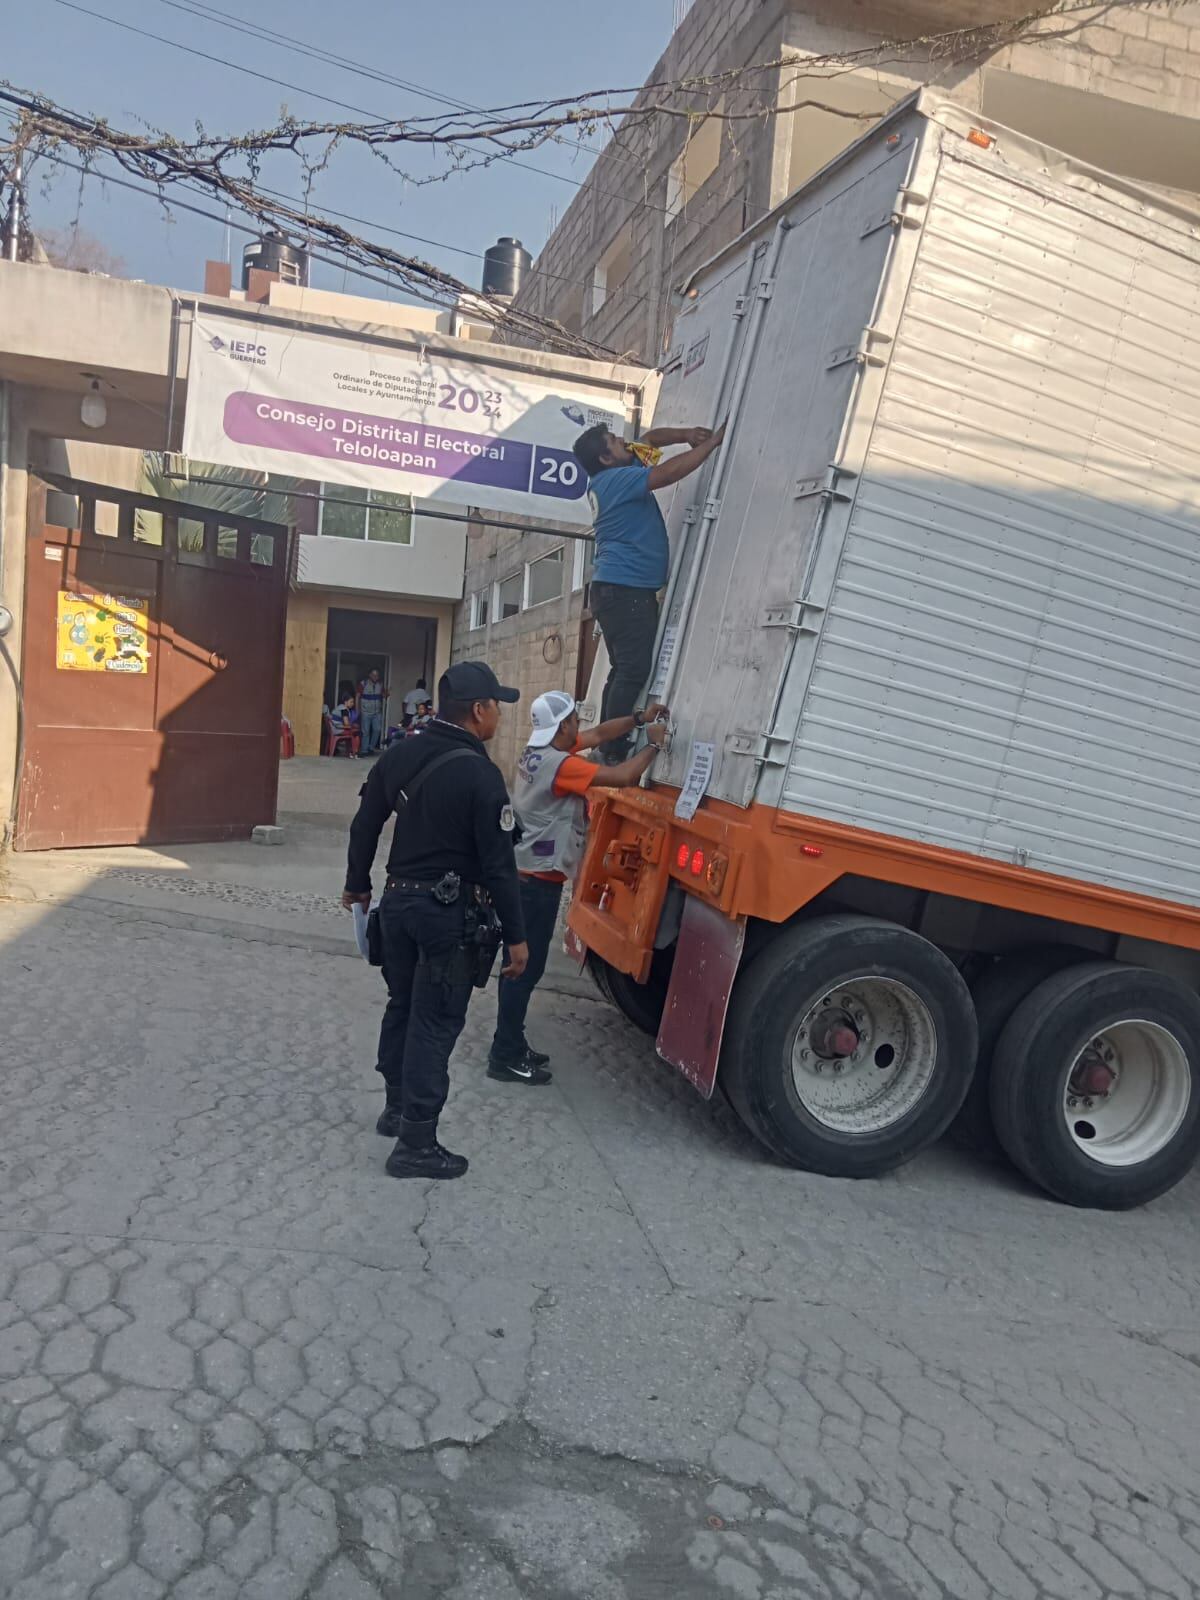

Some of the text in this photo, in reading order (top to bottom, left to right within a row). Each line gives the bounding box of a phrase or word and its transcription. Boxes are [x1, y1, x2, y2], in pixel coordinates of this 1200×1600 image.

[230, 340, 267, 356] IEPC
[230, 353, 266, 365] GUERRERO
[333, 372, 436, 397] Ordinario de Diputaciones
[369, 370, 437, 389] Proceso Electoral
[337, 383, 367, 394] Locales
[376, 390, 436, 406] Ayuntamientos
[438, 384, 502, 413] 20 23
[483, 405, 502, 419] 24
[256, 403, 505, 461] Consejo Distrital Electoral
[332, 437, 437, 470] Teloloapan
[540, 458, 578, 486] 20
